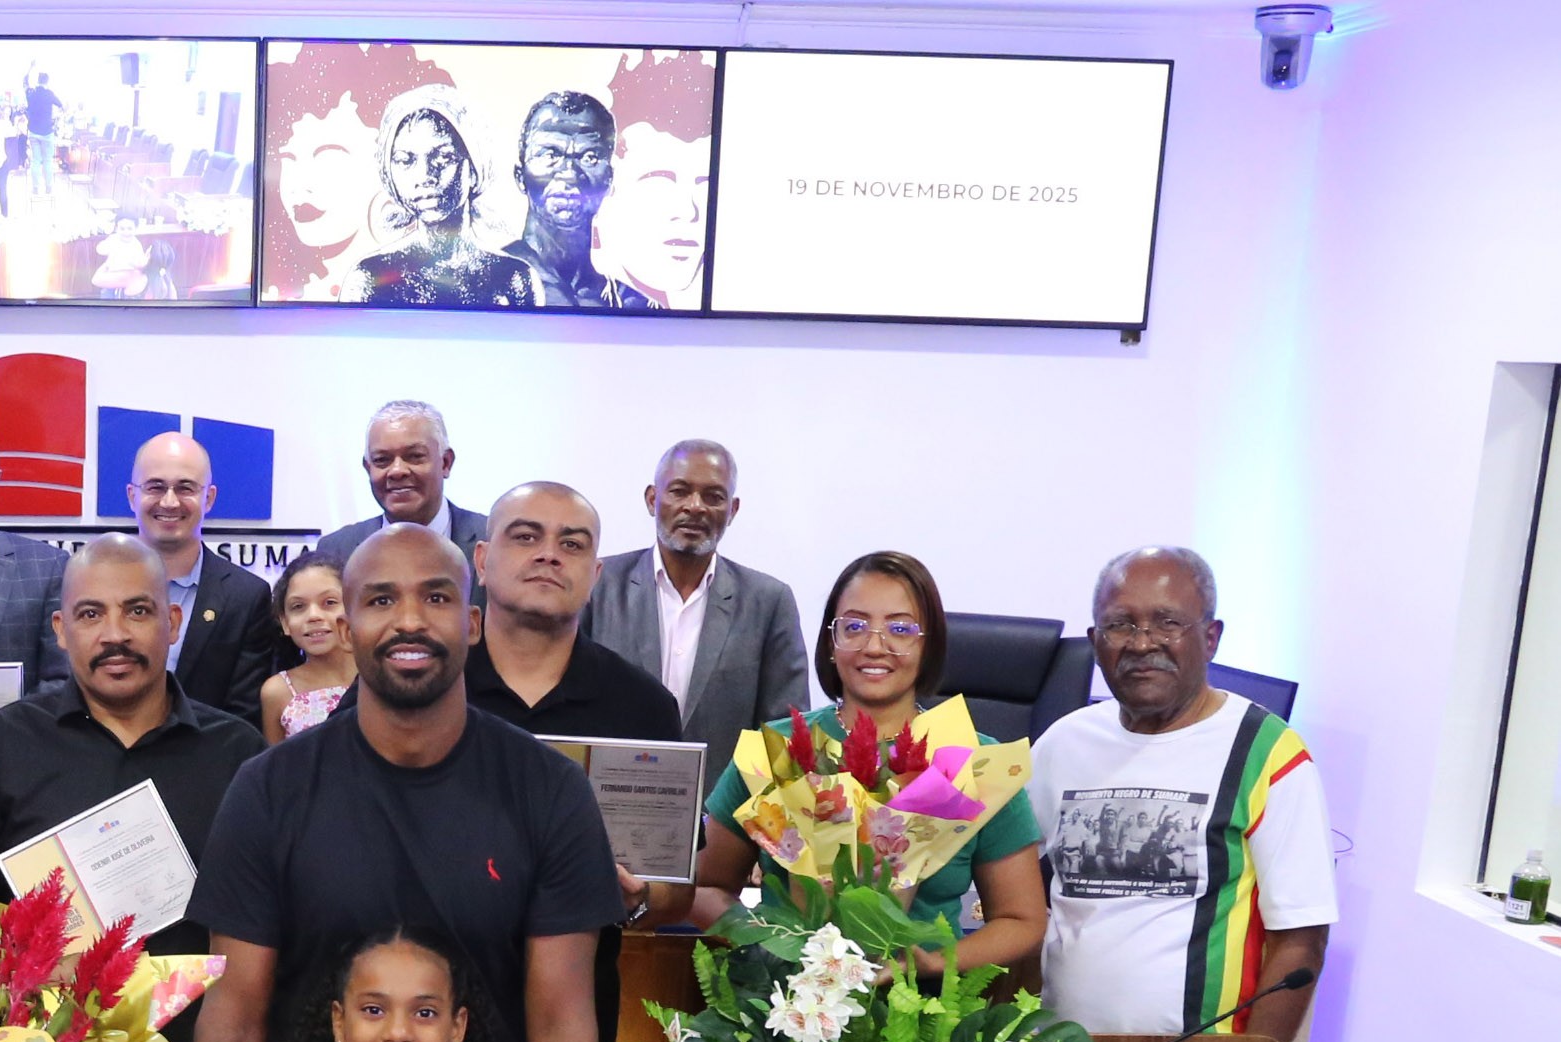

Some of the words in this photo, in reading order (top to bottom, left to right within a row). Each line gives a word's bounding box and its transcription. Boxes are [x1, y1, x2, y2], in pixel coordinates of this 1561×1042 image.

[788, 179, 807, 195] 19
[816, 180, 845, 196] DE
[853, 181, 984, 200] NOVEMBRO
[992, 185, 1021, 201] DE
[1029, 186, 1078, 203] 2025
[601, 784, 632, 793] FERNANDO
[1141, 790, 1153, 798] DE
